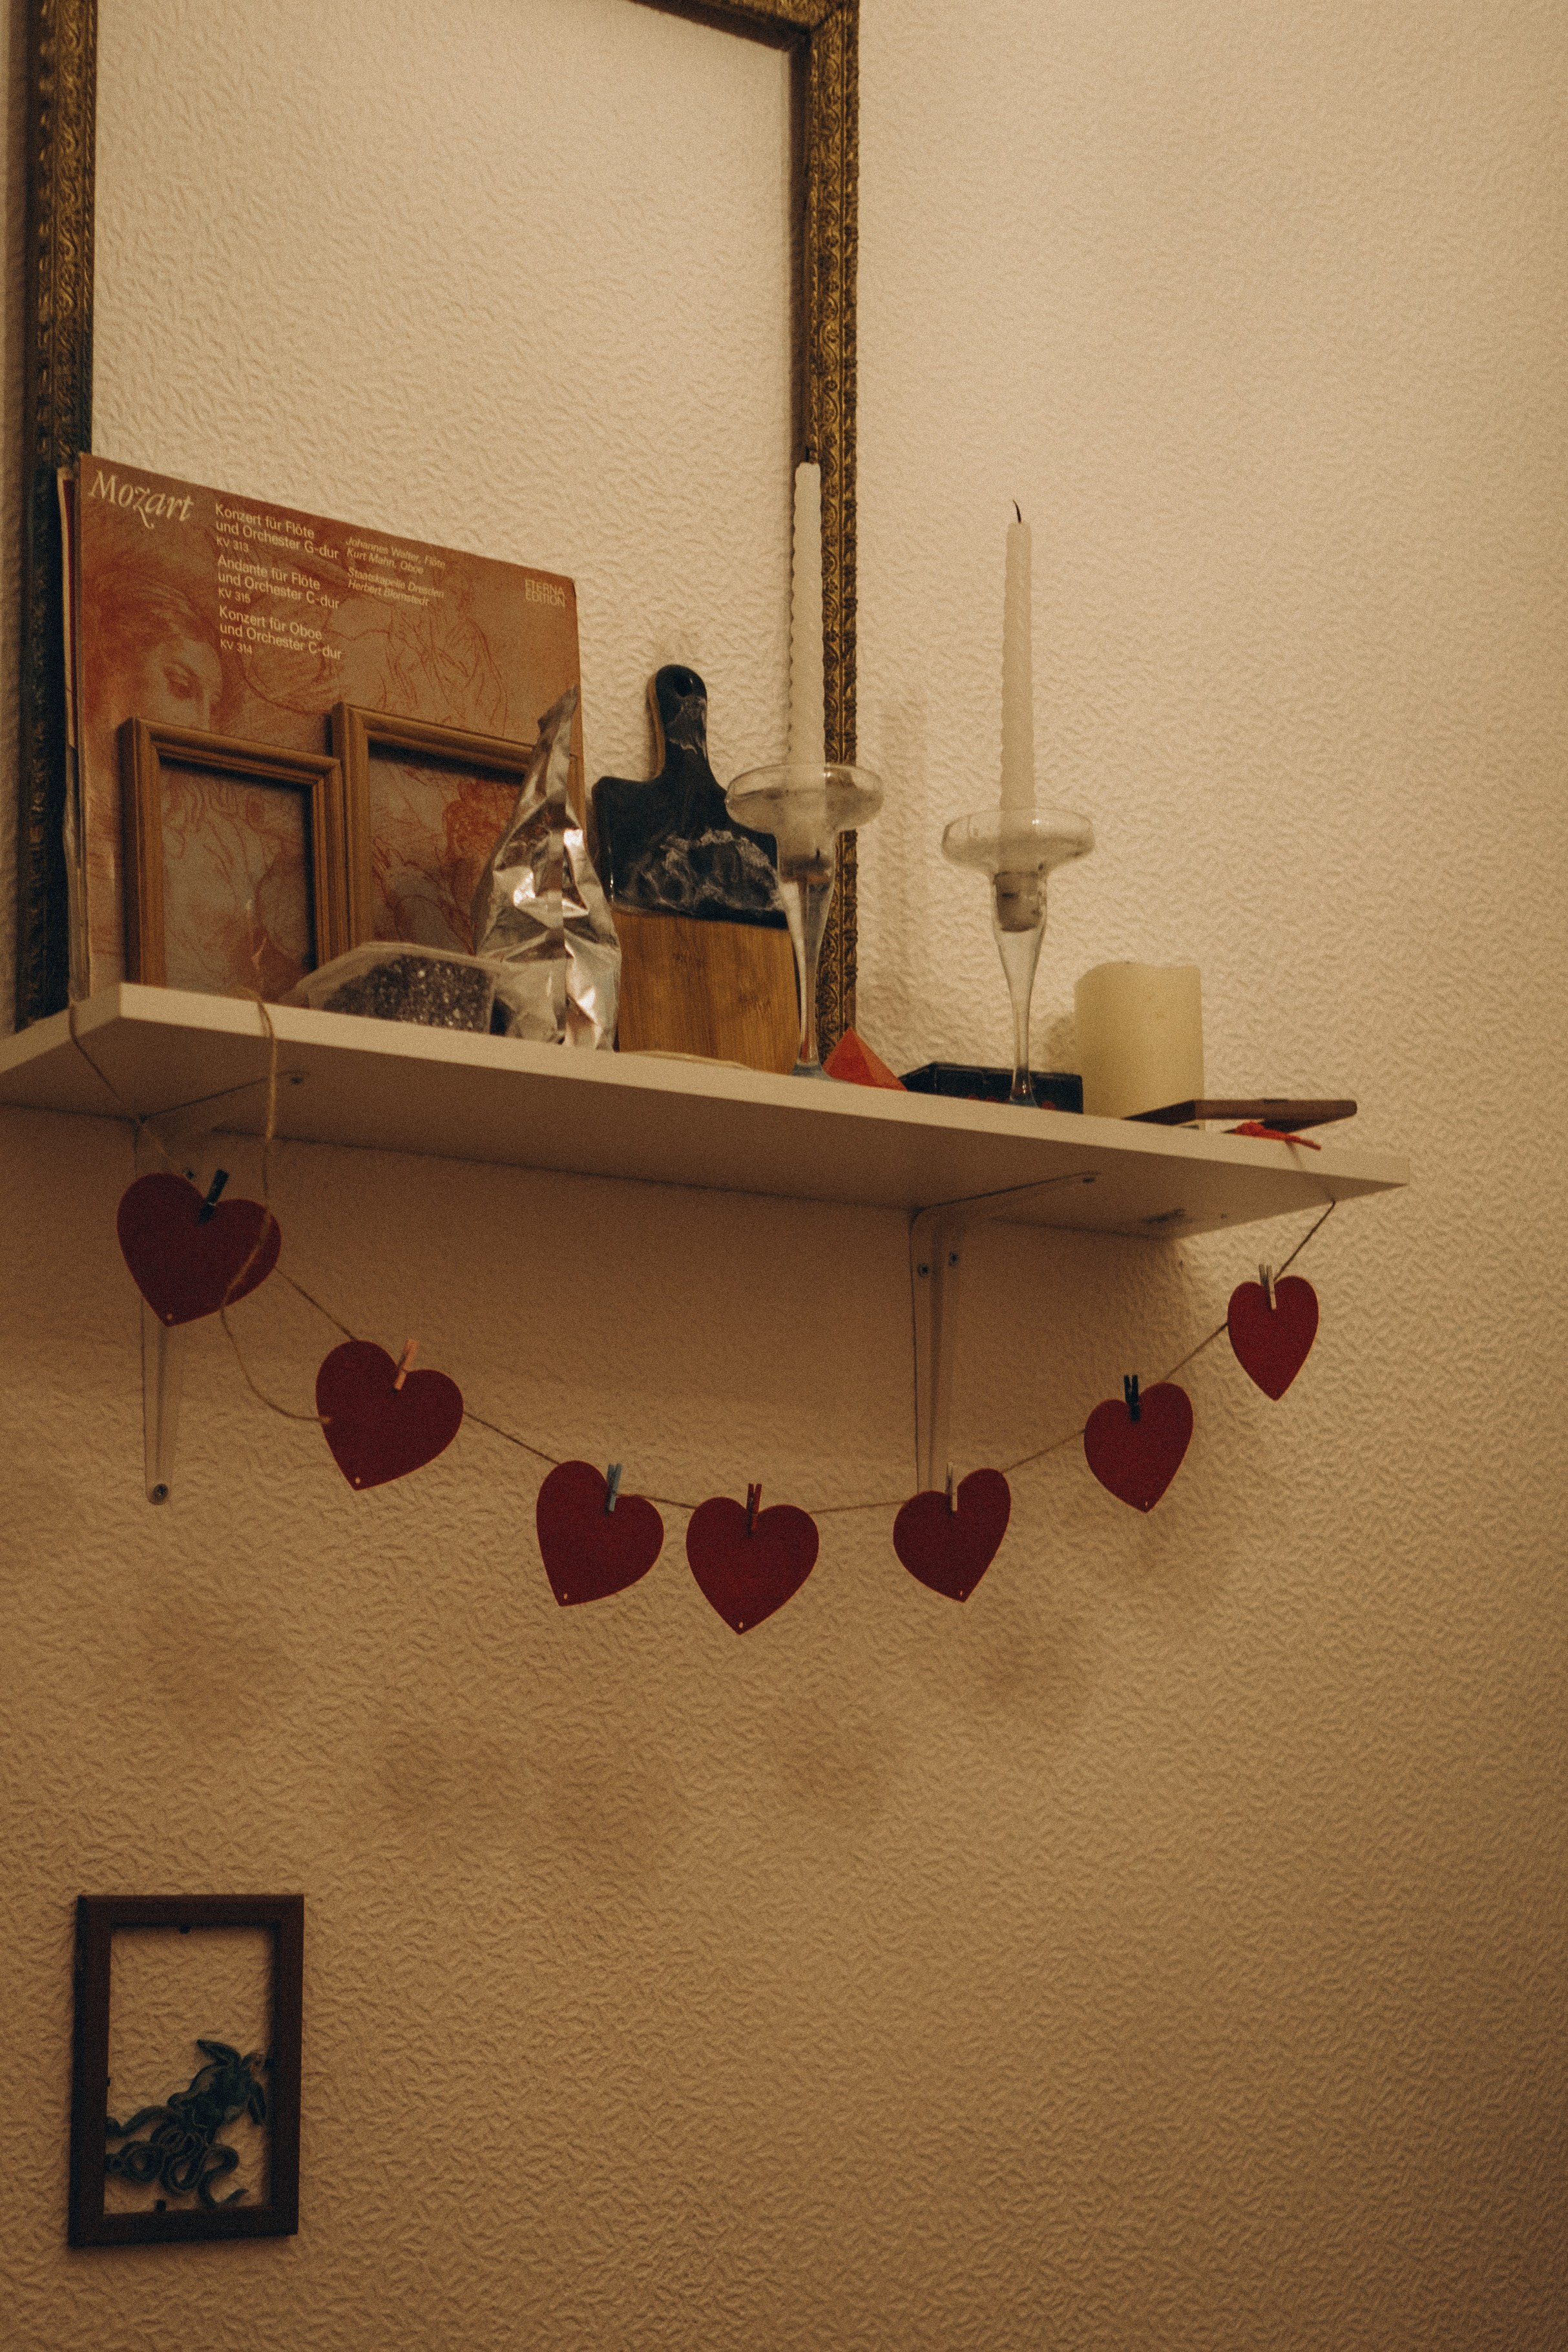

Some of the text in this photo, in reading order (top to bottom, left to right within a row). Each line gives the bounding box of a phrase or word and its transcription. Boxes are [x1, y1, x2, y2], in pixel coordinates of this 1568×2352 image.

[88, 469, 194, 529] Mozart
[215, 501, 315, 539] Konzert für Flöte
[216, 521, 339, 559] und Orchester G-dur
[216, 536, 230, 548] KV
[217, 554, 321, 590] Andante für Flöte
[346, 547, 366, 562] Kurt
[400, 560, 424, 574] Oboe
[218, 572, 340, 609] und Orchester C-dur
[218, 587, 232, 600] KV
[348, 579, 382, 596] Herbert
[525, 578, 566, 597] ETERNA
[219, 605, 322, 640] Konzert für Oboe
[220, 623, 342, 660] und Orchester C-dur
[220, 638, 253, 655] KV 314
